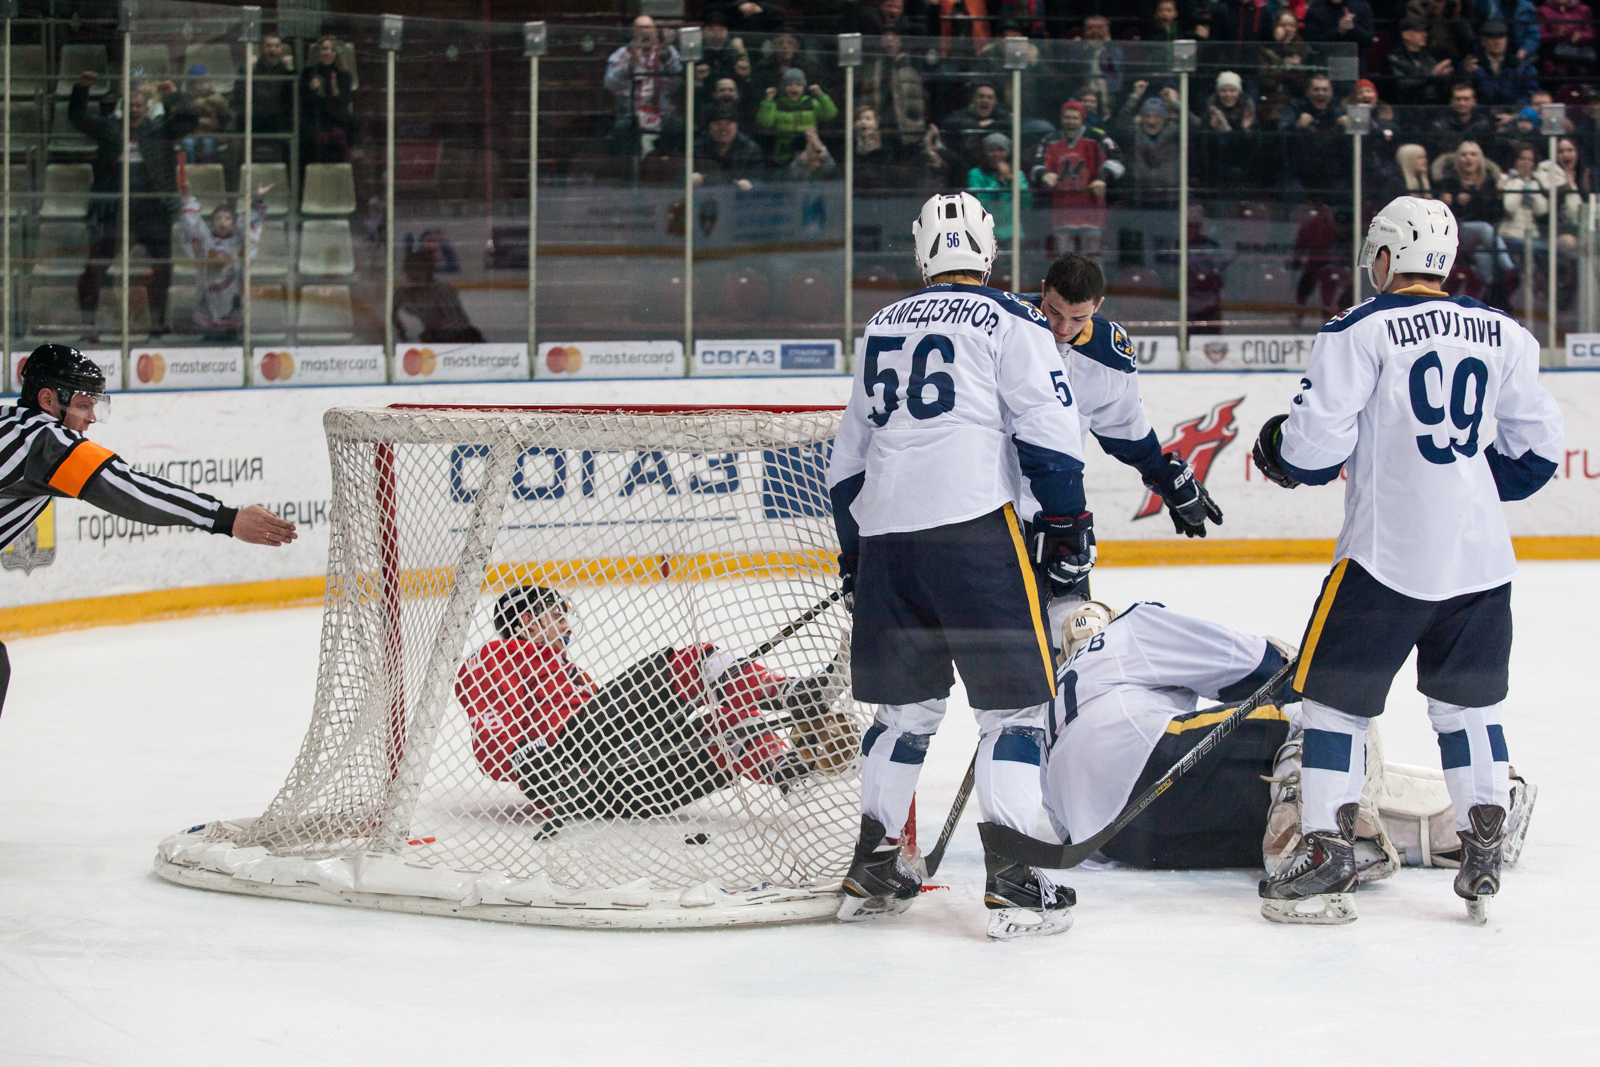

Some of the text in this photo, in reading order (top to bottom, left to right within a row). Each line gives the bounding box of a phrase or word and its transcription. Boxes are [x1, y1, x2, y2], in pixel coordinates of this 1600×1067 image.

[946, 231, 960, 248] 56
[1425, 252, 1446, 270] 99
[301, 357, 377, 371] mastercard
[443, 352, 519, 367] mastercard
[590, 350, 674, 364] mastercard
[702, 350, 775, 364] СОГАЗ
[170, 358, 237, 373] mastercard
[864, 334, 955, 427] 56
[1409, 351, 1488, 464] 99
[451, 443, 739, 502] СОГАЗ
[1075, 616, 1087, 628] 40
